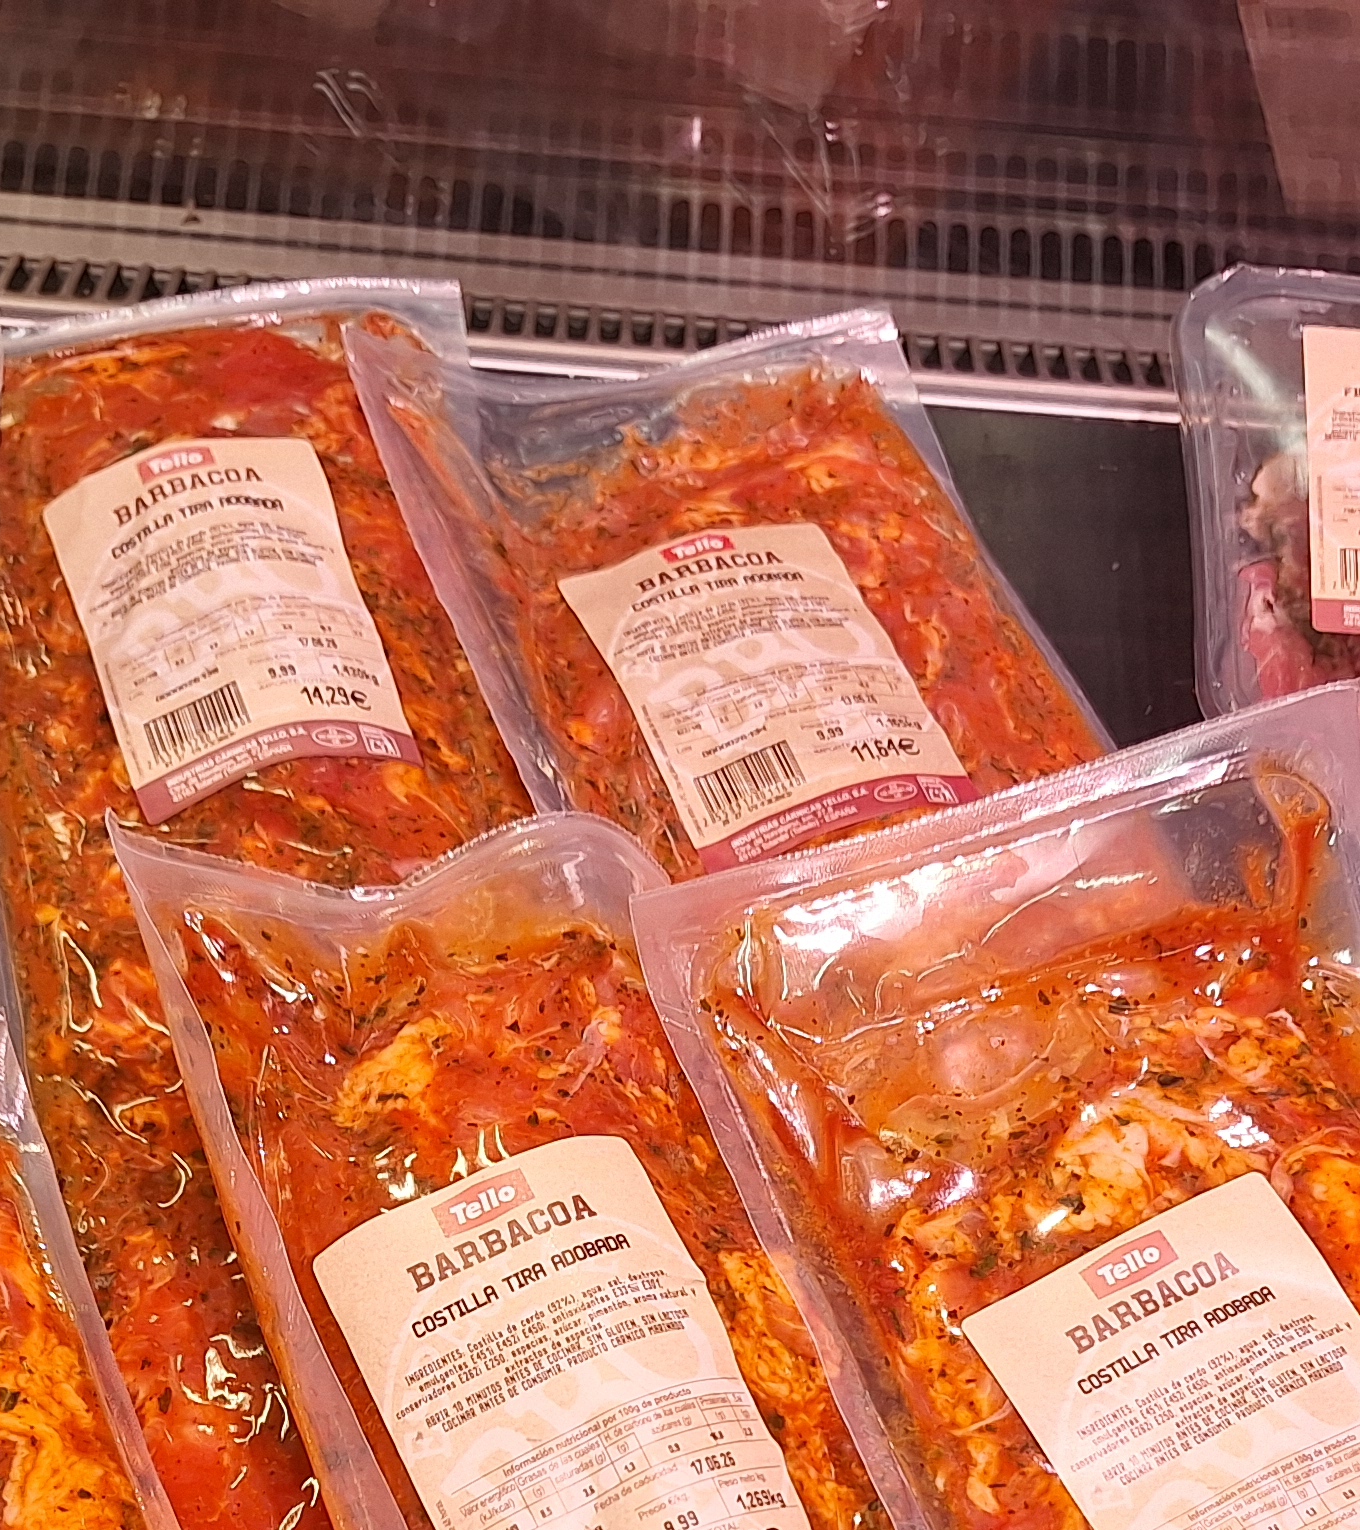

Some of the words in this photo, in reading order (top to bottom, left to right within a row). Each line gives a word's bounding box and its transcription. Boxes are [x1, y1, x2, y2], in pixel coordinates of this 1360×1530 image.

[148, 450, 204, 476] Tello
[112, 467, 262, 527] BARBACOA
[111, 513, 175, 560] COSTILLA
[178, 501, 214, 522] TIRA
[672, 536, 725, 560] Tello
[635, 550, 783, 593] BARBACOA
[631, 584, 700, 613] COSTILLA
[300, 685, 372, 711] 14,29€
[849, 738, 920, 763] 11,64€
[447, 1178, 519, 1227] Tello
[405, 1190, 597, 1293] BARBACOA
[1095, 1240, 1166, 1289] Tello
[409, 1283, 500, 1340] COSTILLA
[500, 1260, 548, 1295] TIRA
[549, 1231, 632, 1273] ADOBADA
[1063, 1248, 1240, 1355] BARBACOA
[1075, 1341, 1161, 1397] COSTILLA
[1158, 1318, 1204, 1350] TIRA
[1201, 1284, 1277, 1328] ADOBADA
[688, 1450, 737, 1477] 17.06.26
[733, 1487, 788, 1515] 1,269kg
